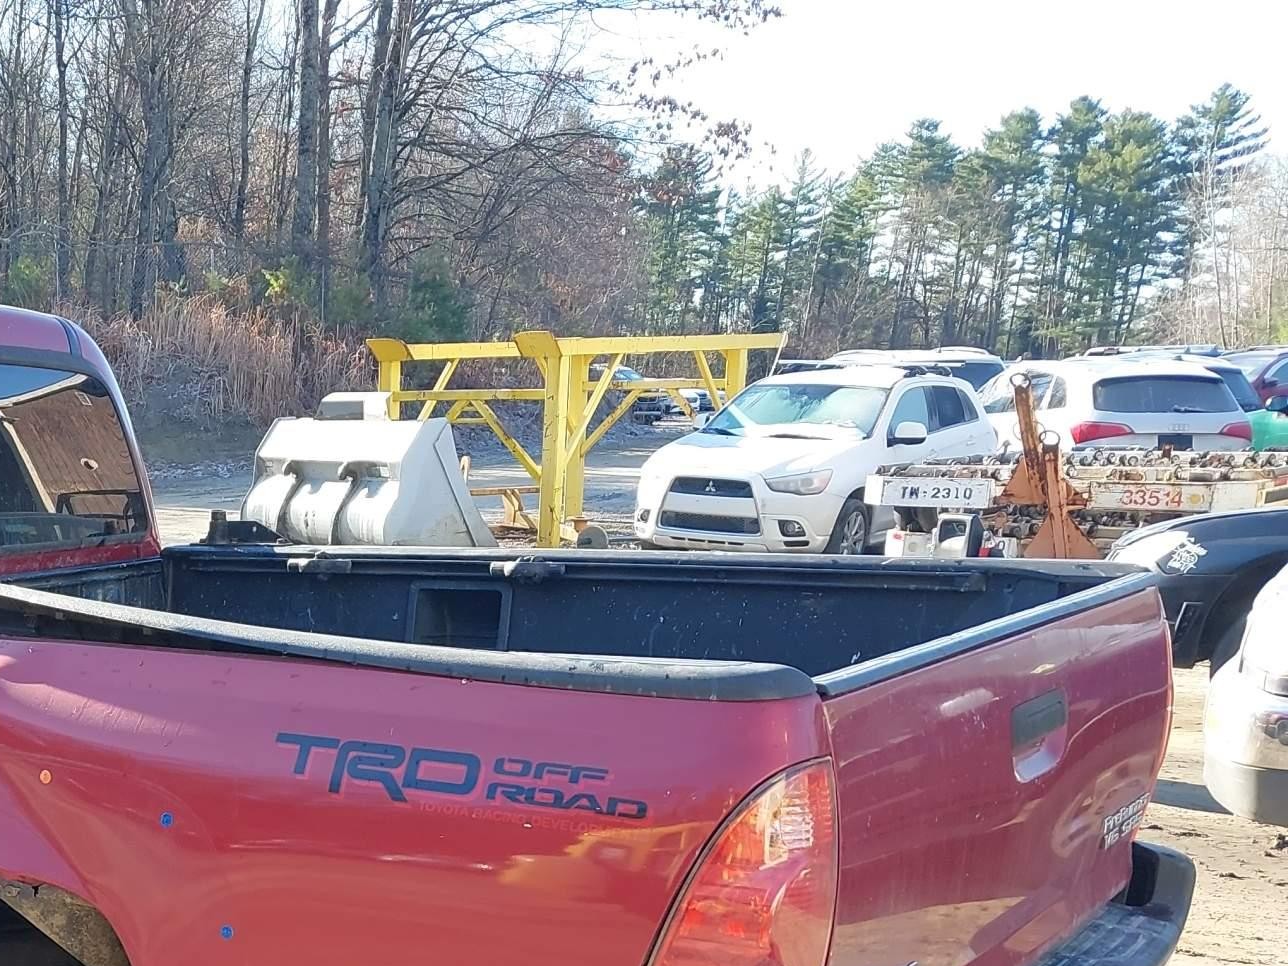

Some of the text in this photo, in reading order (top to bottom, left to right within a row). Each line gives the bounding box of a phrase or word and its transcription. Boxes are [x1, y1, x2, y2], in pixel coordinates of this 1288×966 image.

[275, 732, 481, 803] TRD
[493, 757, 609, 784] OFF
[486, 782, 648, 820] ROAD
